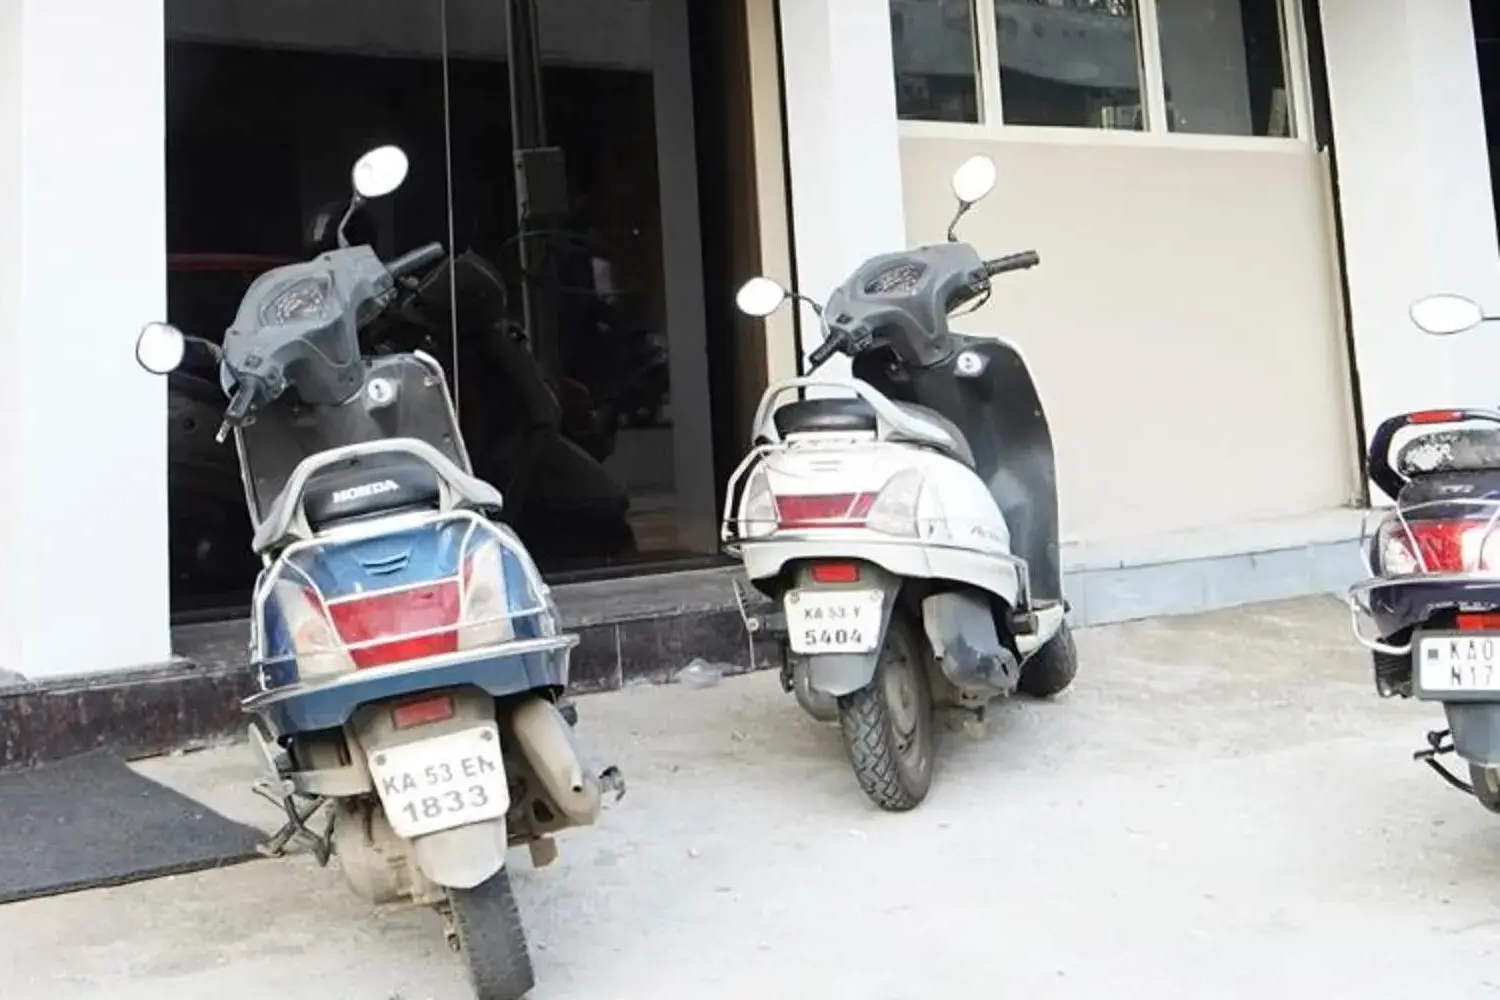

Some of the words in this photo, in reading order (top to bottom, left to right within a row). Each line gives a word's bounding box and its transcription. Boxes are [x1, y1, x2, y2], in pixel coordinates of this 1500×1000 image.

[332, 479, 401, 503] HONDA
[804, 627, 862, 646] 5404
[381, 772, 417, 796] KA
[423, 762, 454, 786] 53
[402, 784, 489, 824] 1833
